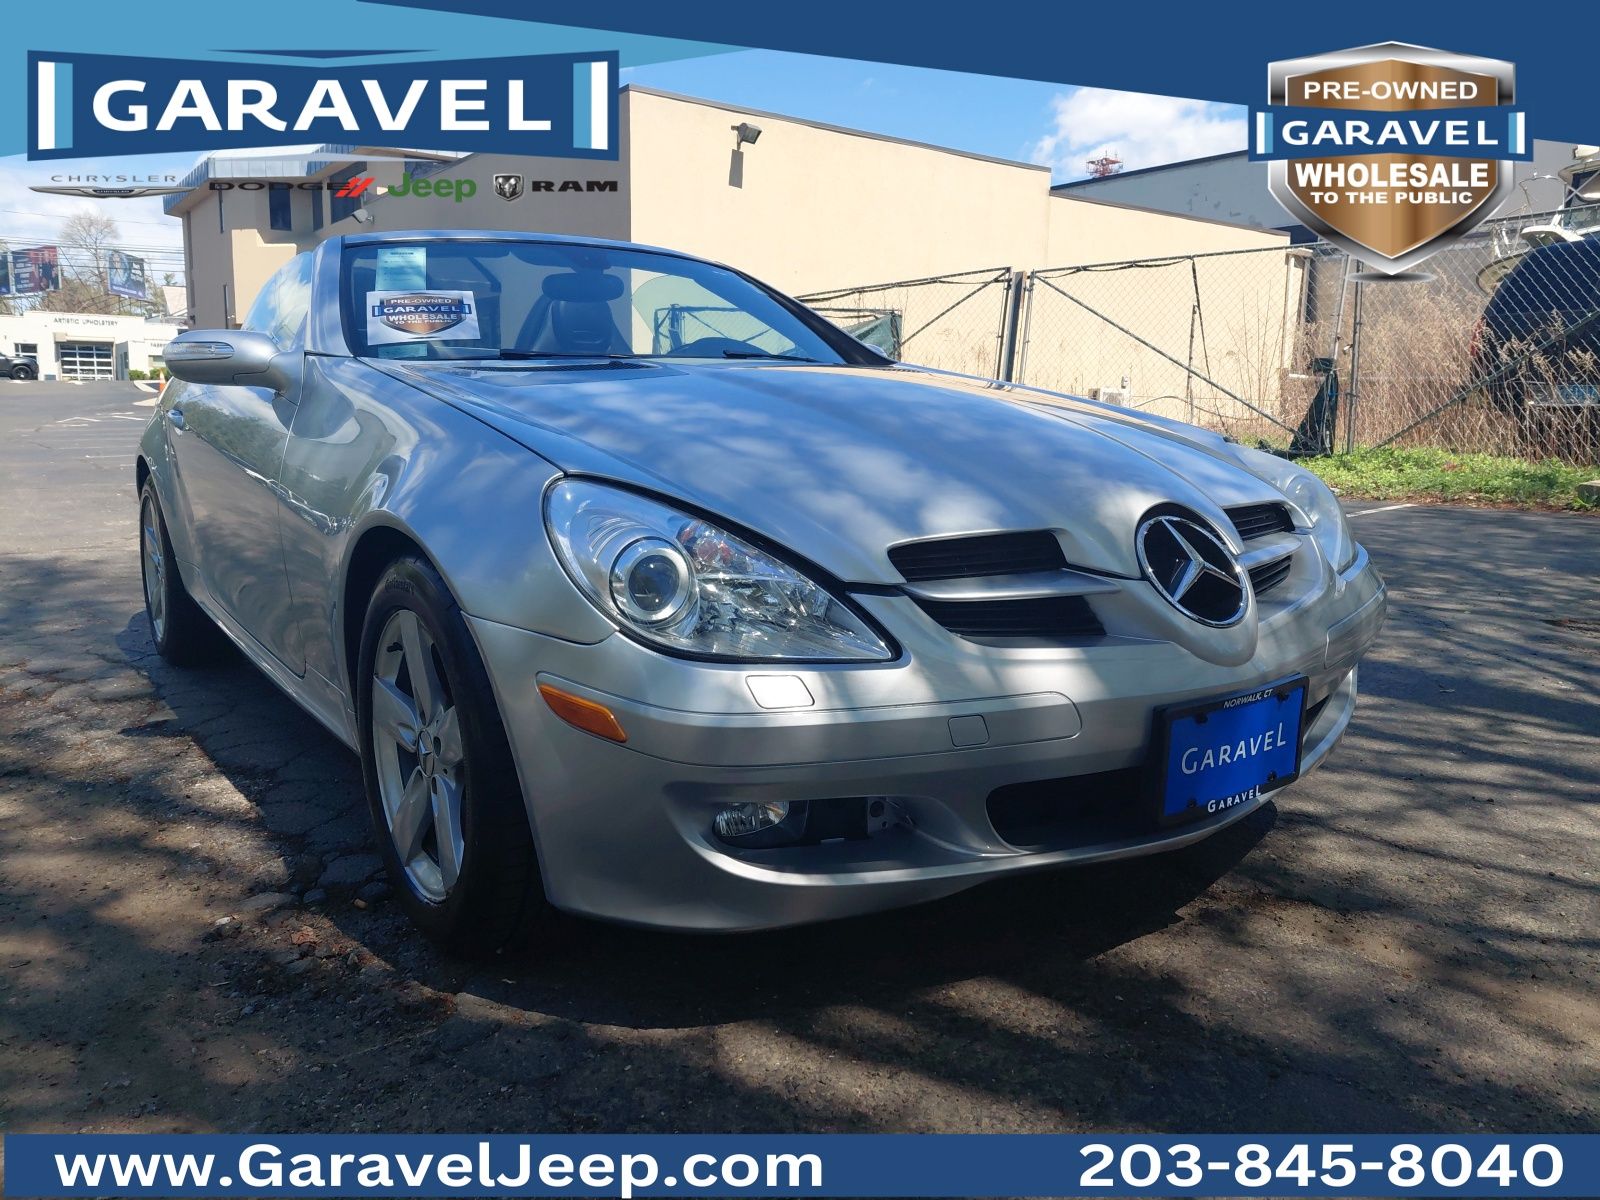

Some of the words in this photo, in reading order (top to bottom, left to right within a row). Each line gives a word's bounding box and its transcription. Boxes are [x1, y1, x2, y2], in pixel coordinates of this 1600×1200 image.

[383, 305, 460, 313] GARAVEL
[54, 317, 80, 325] ARTISTIC
[388, 313, 458, 321] WHOLESALE
[1263, 689, 1274, 698] CT
[1181, 722, 1287, 775] GARAVEL
[1207, 784, 1261, 813] GARAVEL
